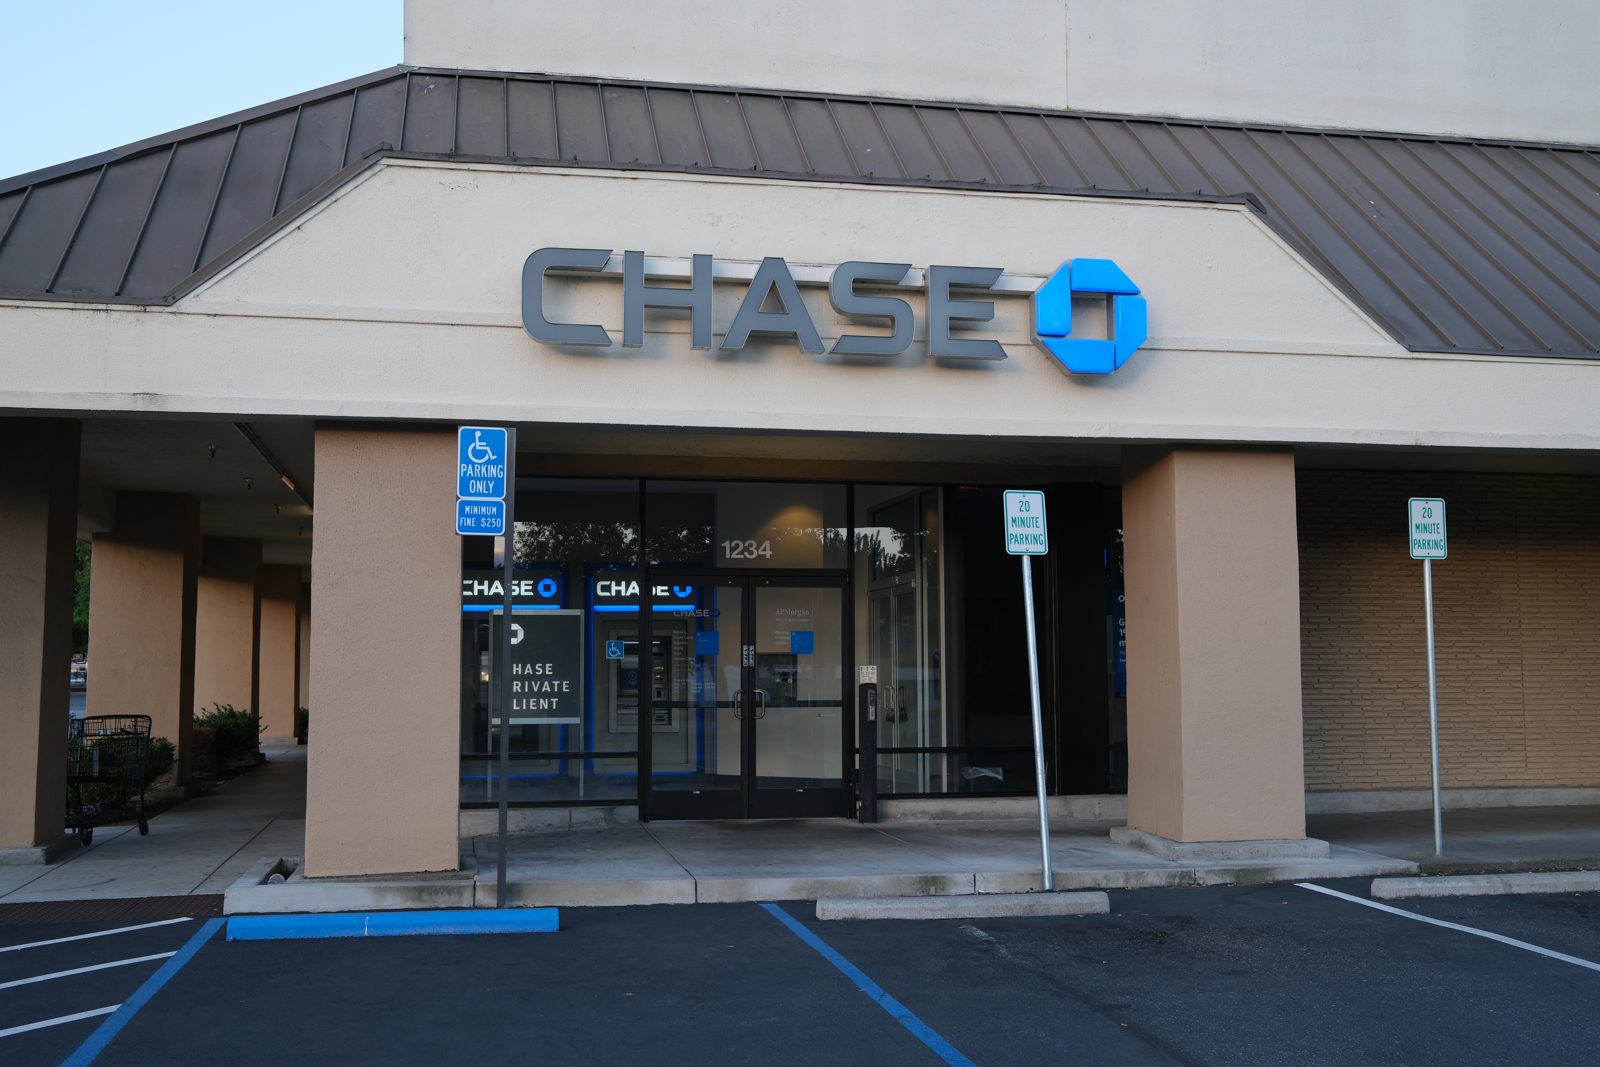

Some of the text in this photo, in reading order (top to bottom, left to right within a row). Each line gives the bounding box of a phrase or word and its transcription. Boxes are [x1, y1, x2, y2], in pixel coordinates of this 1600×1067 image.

[521, 247, 1008, 361] CHASE
[460, 463, 504, 478] PARKING
[469, 479, 495, 494] ONLY
[464, 505, 497, 515] MINIMUM
[1019, 500, 1030, 512] 20
[1422, 507, 1432, 518] 20
[460, 517, 501, 528] FINE $250
[1011, 516, 1040, 528] MINUTE
[1415, 523, 1440, 534] MINUTE
[1009, 533, 1044, 545] PARKING
[1413, 539, 1443, 550] PARKING
[721, 540, 772, 559] 1234
[596, 581, 670, 596] CHAE
[513, 663, 553, 675] HASE
[513, 681, 570, 692] RIVATE
[513, 698, 559, 710] LIENT
